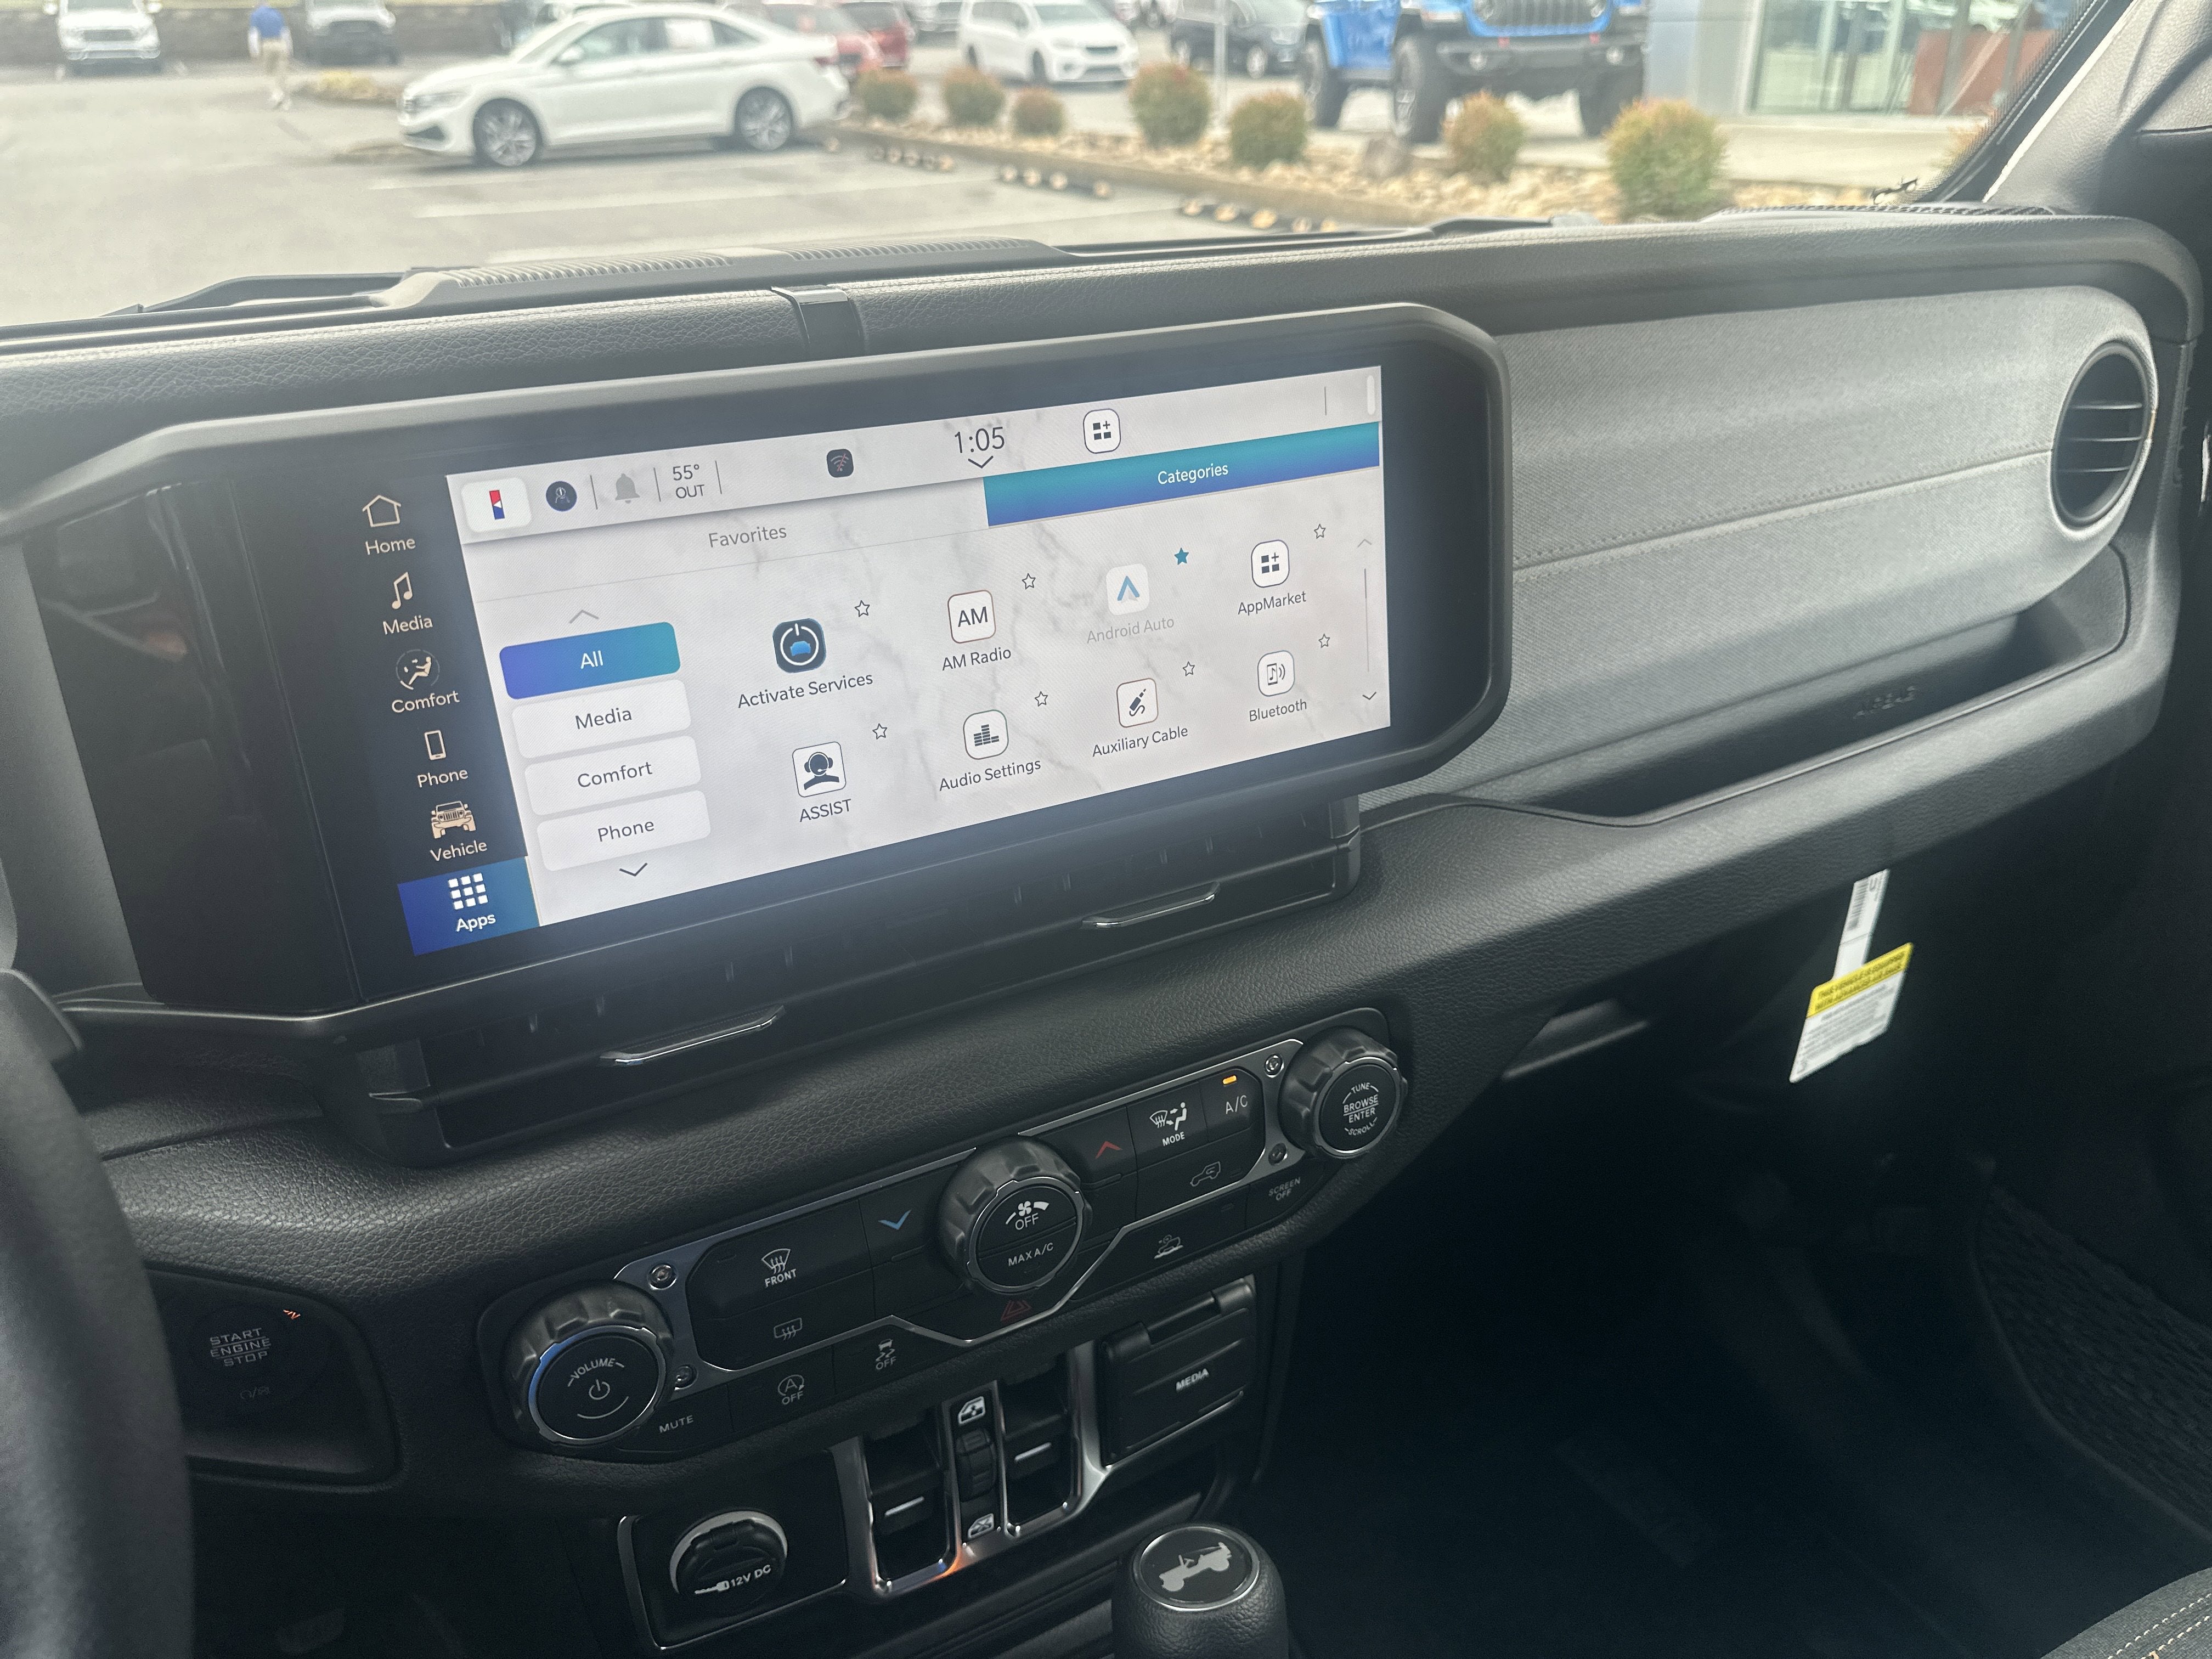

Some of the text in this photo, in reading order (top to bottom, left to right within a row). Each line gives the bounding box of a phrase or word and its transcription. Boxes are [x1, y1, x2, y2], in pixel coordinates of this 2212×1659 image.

[954, 426, 1005, 454] 1:05
[673, 464, 699, 481] 55°
[1158, 462, 1228, 484] Categories
[675, 484, 704, 499] OUT
[365, 538, 416, 555] Home
[708, 526, 787, 548] Favorites
[1238, 591, 1307, 616] AppMarket
[382, 615, 433, 635] Media
[958, 606, 988, 628] AM
[1087, 618, 1175, 644] Android Auto
[580, 650, 603, 669] All
[942, 647, 1012, 671] AM Radio
[391, 690, 460, 713] Comfort
[738, 674, 873, 709] Activate Services
[575, 707, 632, 730] Media
[1249, 698, 1307, 722] Bluetooth
[1092, 726, 1188, 757] Auxiliary Cable
[417, 770, 469, 788] Phone
[577, 761, 653, 788] Comfort
[939, 760, 1041, 792] Audio Settings
[799, 798, 851, 822] ASSIST
[597, 821, 654, 842] Phone
[430, 840, 487, 861] Vehicle
[456, 914, 496, 932] Apps
[1351, 1082, 1370, 1093] TUNE
[1226, 1094, 1248, 1114] A/C
[1344, 1094, 1378, 1113] BROWSE
[1349, 1107, 1375, 1123] ENTER
[1162, 1131, 1185, 1146] MODE
[1348, 1122, 1375, 1136] SCROLL
[1268, 1177, 1300, 1196] SCREEN
[1276, 1188, 1291, 1201] OFF
[1015, 1212, 1039, 1230] OFF
[1008, 1242, 1053, 1266] MAX A/C
[765, 1268, 796, 1287] FRONT
[210, 1328, 262, 1346] START
[210, 1338, 272, 1358] ENGINE
[224, 1351, 267, 1367] STOP
[571, 1358, 616, 1379] VOLUME
[876, 1356, 896, 1370] OFF
[1176, 1368, 1209, 1391] MEDIA
[781, 1391, 803, 1405] OFF
[659, 1415, 693, 1433] MUTE
[731, 1564, 771, 1587] 12V DC
